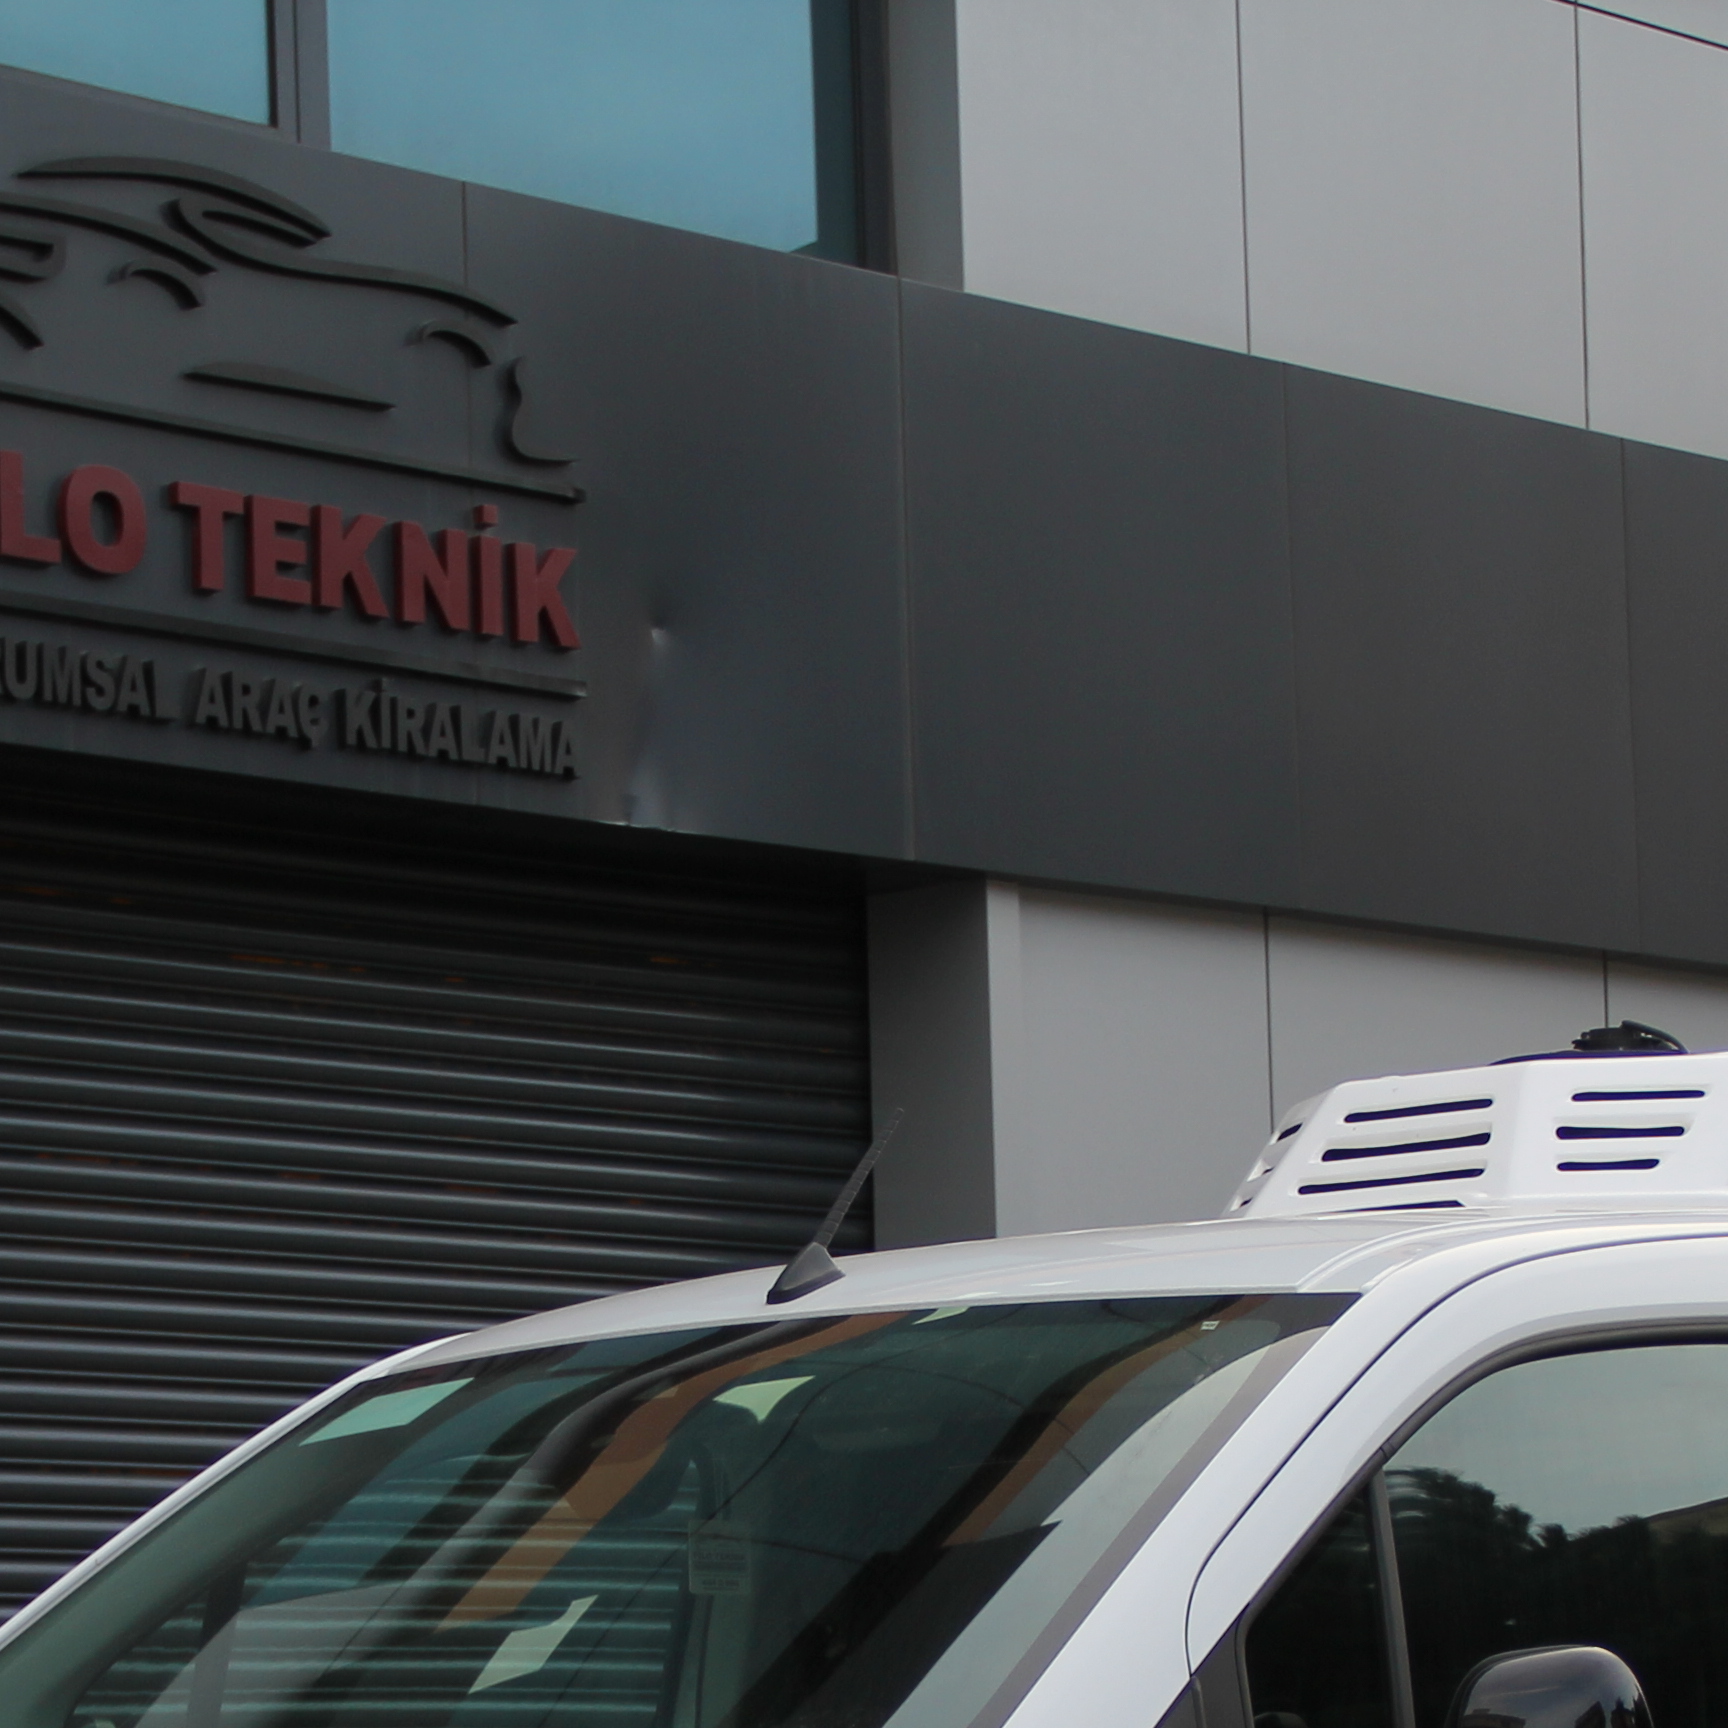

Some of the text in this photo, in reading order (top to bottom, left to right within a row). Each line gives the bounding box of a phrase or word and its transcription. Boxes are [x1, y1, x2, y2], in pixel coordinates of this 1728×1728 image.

[168, 480, 582, 652] TEKNİK
[192, 667, 326, 749] ARAÇ
[340, 677, 579, 775] KİRALAMA
